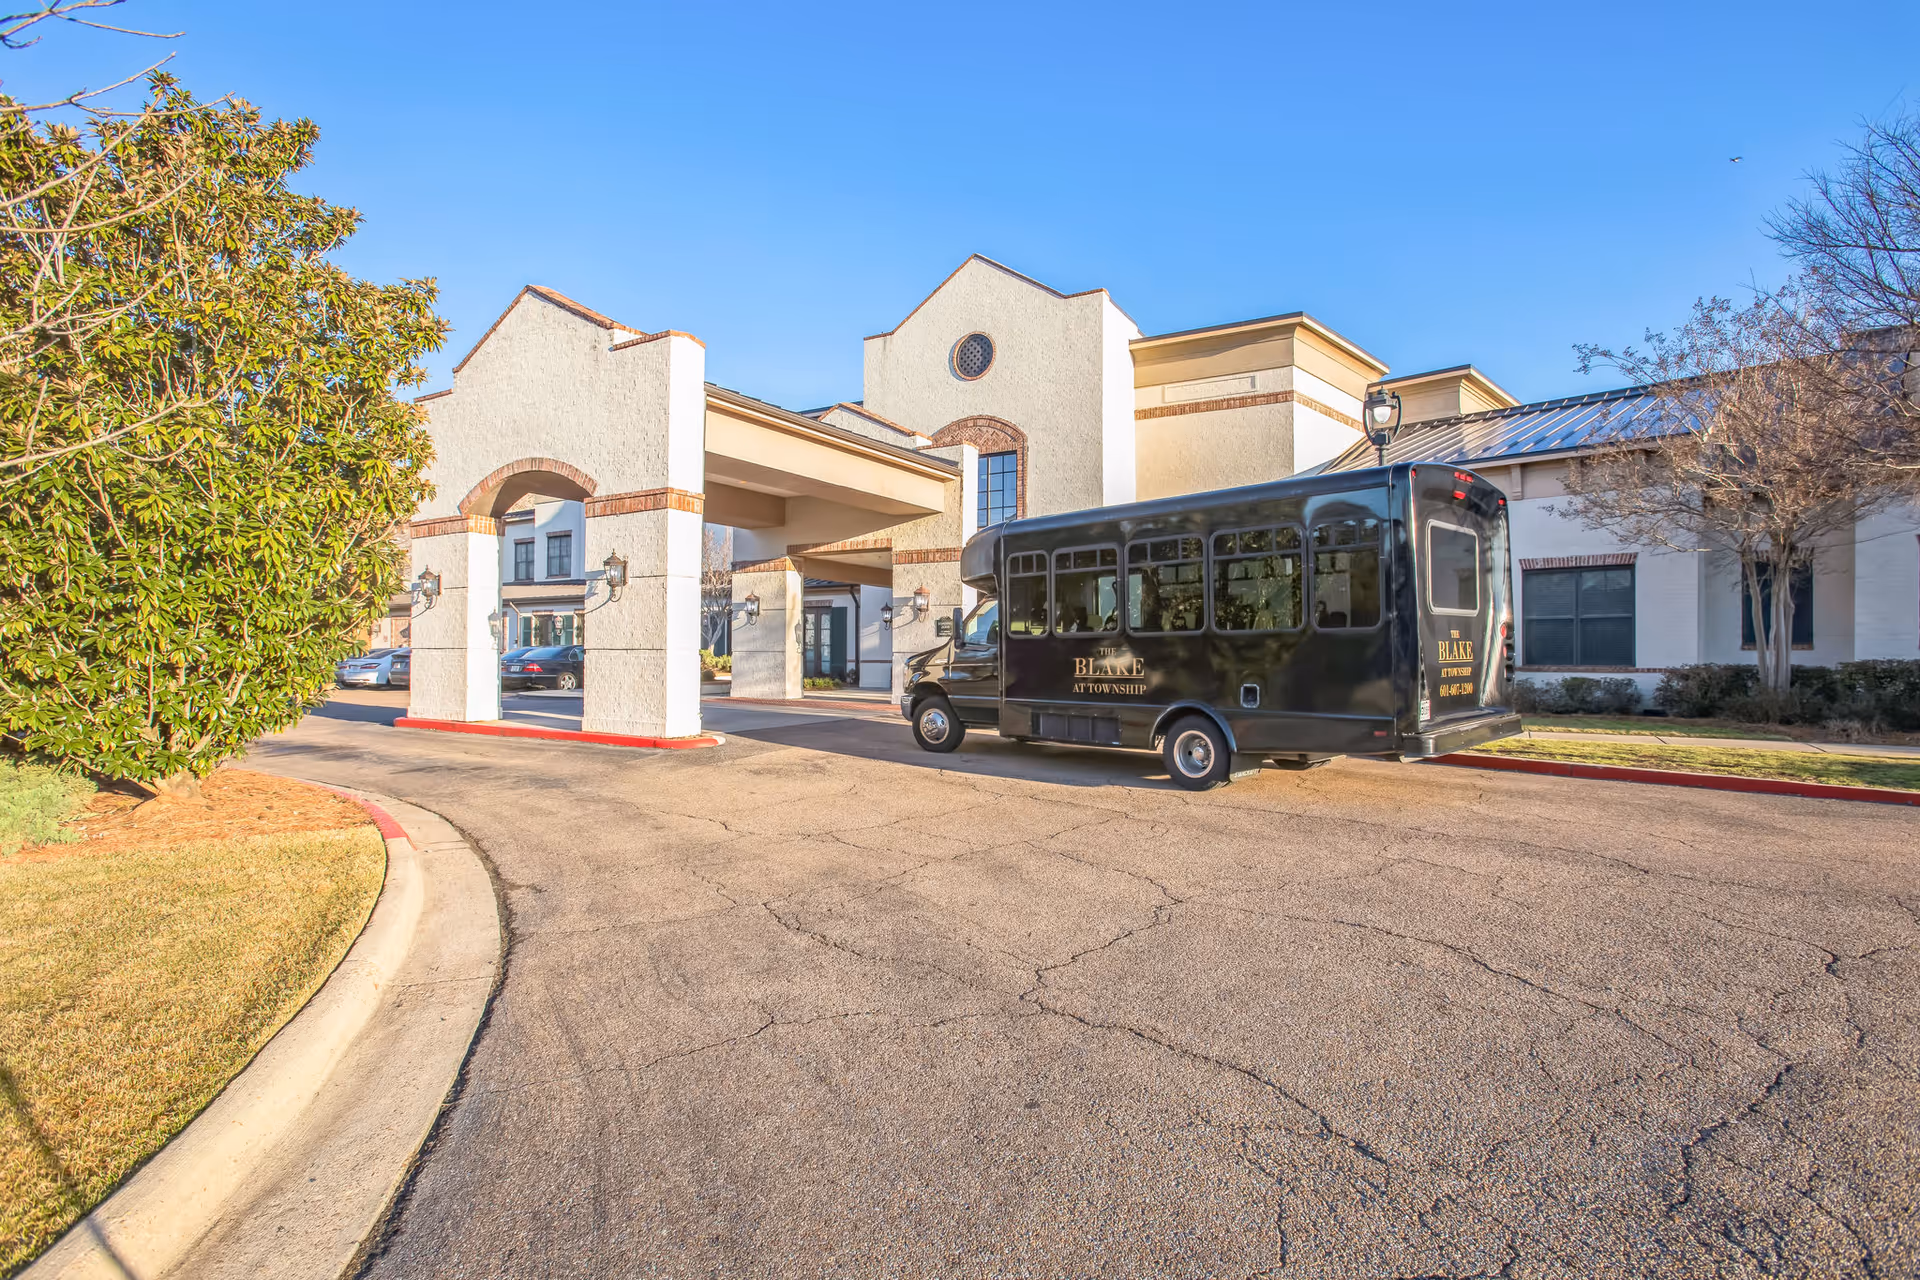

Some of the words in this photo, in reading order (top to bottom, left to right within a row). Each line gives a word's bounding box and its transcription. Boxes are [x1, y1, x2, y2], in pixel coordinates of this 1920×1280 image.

[1450, 629, 1460, 639] THE
[1099, 647, 1117, 656] THE
[1438, 640, 1474, 661] BLAKE
[1073, 657, 1145, 676] BLAKE
[1441, 667, 1447, 678] AT
[1448, 666, 1472, 678] TOWNSHIP
[1073, 683, 1086, 693] AT
[1087, 683, 1147, 695] TOWNSHIP
